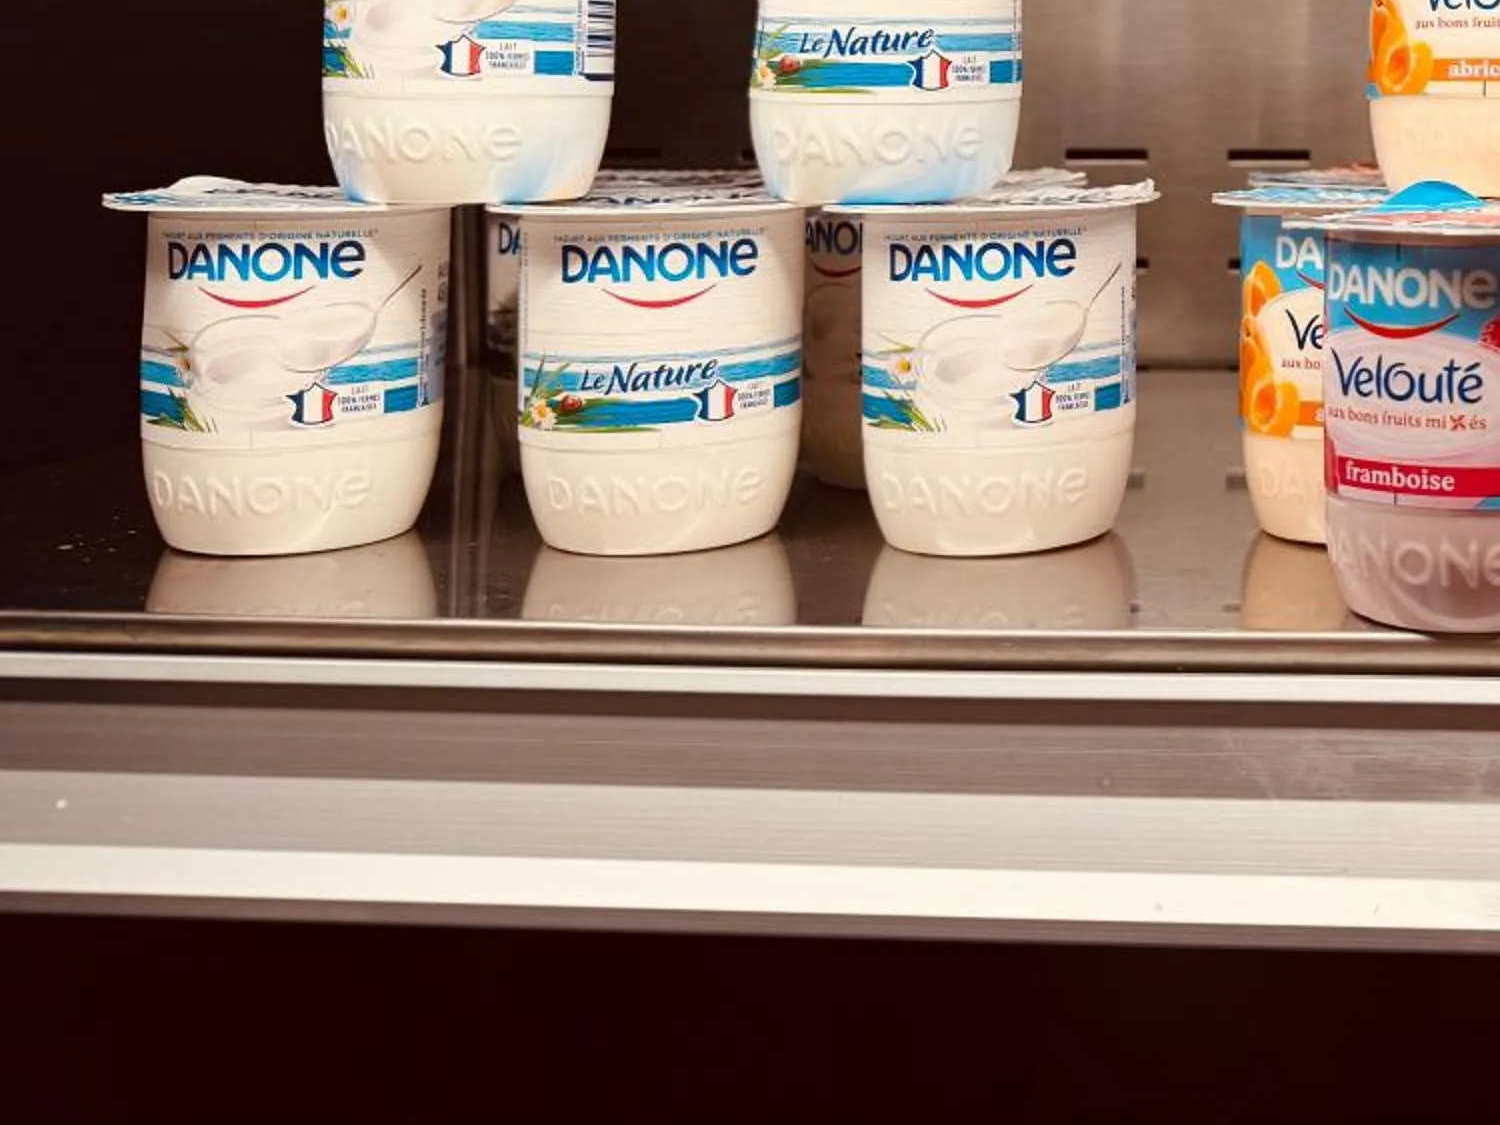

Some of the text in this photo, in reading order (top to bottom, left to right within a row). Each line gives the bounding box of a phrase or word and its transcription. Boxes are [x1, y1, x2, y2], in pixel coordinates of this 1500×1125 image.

[1437, 17, 1469, 28] bons
[824, 26, 935, 57] Nature
[805, 221, 863, 255] ANO
[581, 358, 719, 395] Le Nature
[1304, 357, 1321, 370] bo
[1331, 347, 1484, 405] Velouté
[1348, 406, 1379, 424] bons
[1382, 409, 1421, 429] fruits
[1345, 460, 1455, 492] framboise
